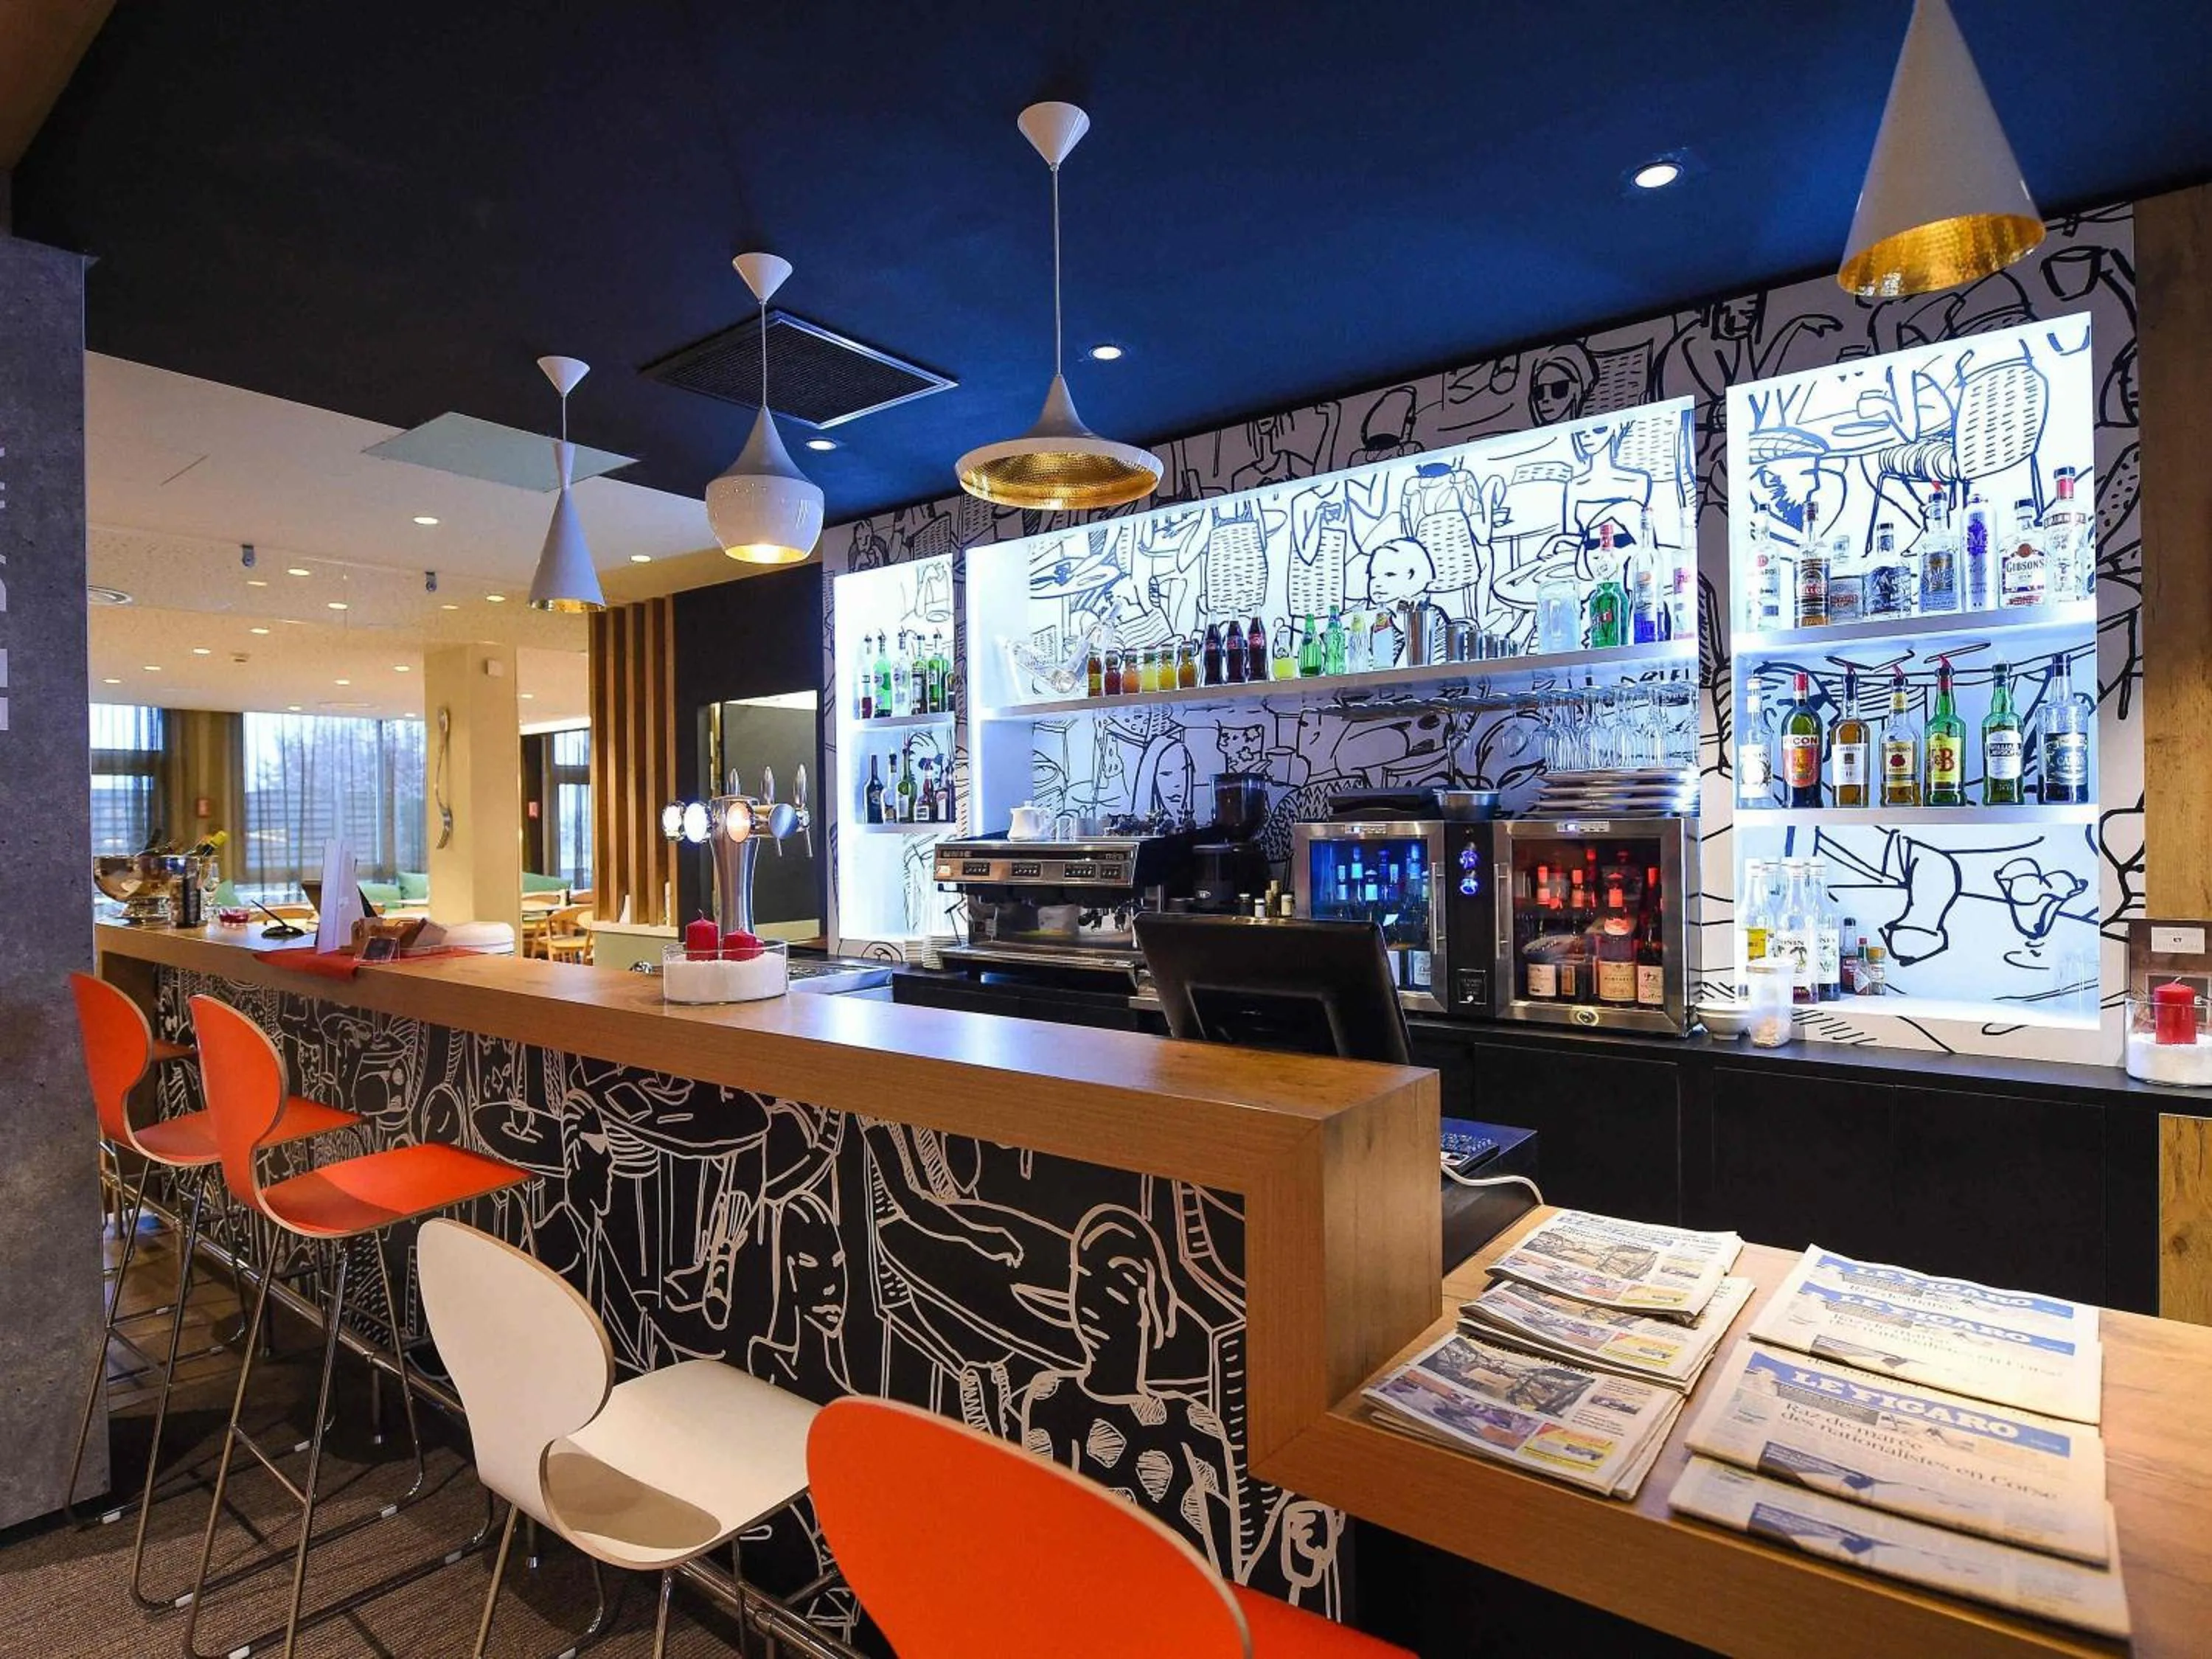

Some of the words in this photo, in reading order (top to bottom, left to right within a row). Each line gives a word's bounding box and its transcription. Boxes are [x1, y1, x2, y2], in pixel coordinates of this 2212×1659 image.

[1903, 1276, 2033, 1307] FIGARO
[1889, 1307, 2031, 1344] FIGARO
[1792, 1371, 1844, 1395] LE
[1848, 1383, 2019, 1439] FIGARO
